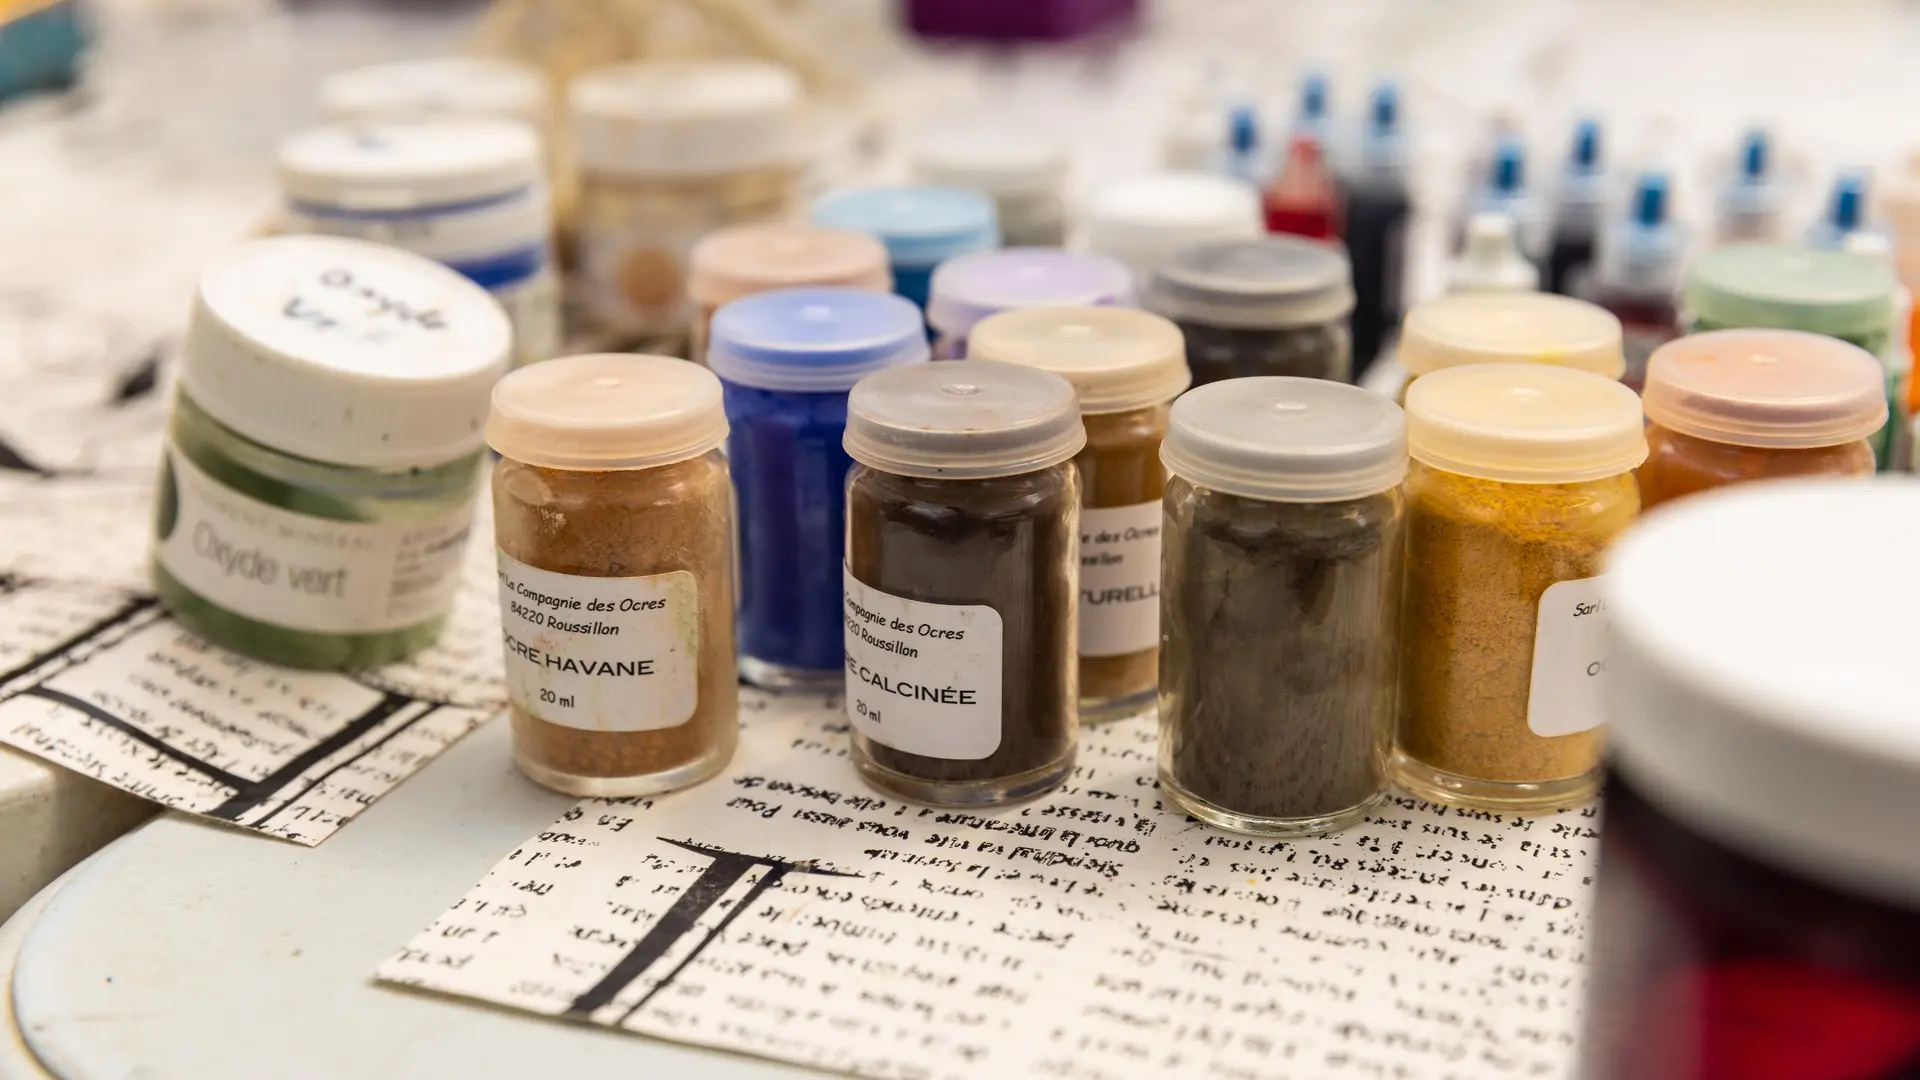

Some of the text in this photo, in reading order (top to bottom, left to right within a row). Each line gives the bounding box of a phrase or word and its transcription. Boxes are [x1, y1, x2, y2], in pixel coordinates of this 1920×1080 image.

[286, 566, 348, 599] vert
[516, 583, 582, 612] Compagnie
[586, 597, 615, 613] des
[619, 598, 667, 613] Ocres
[510, 601, 620, 636] 84220 Roussillon
[890, 617, 915, 634] des
[917, 623, 965, 640] Ocres
[861, 627, 919, 659] Roussillon
[545, 653, 656, 677] HAVANE
[539, 688, 575, 708] 20 ml
[859, 666, 977, 705] CALCINÉE
[856, 698, 882, 724] 20 ml
